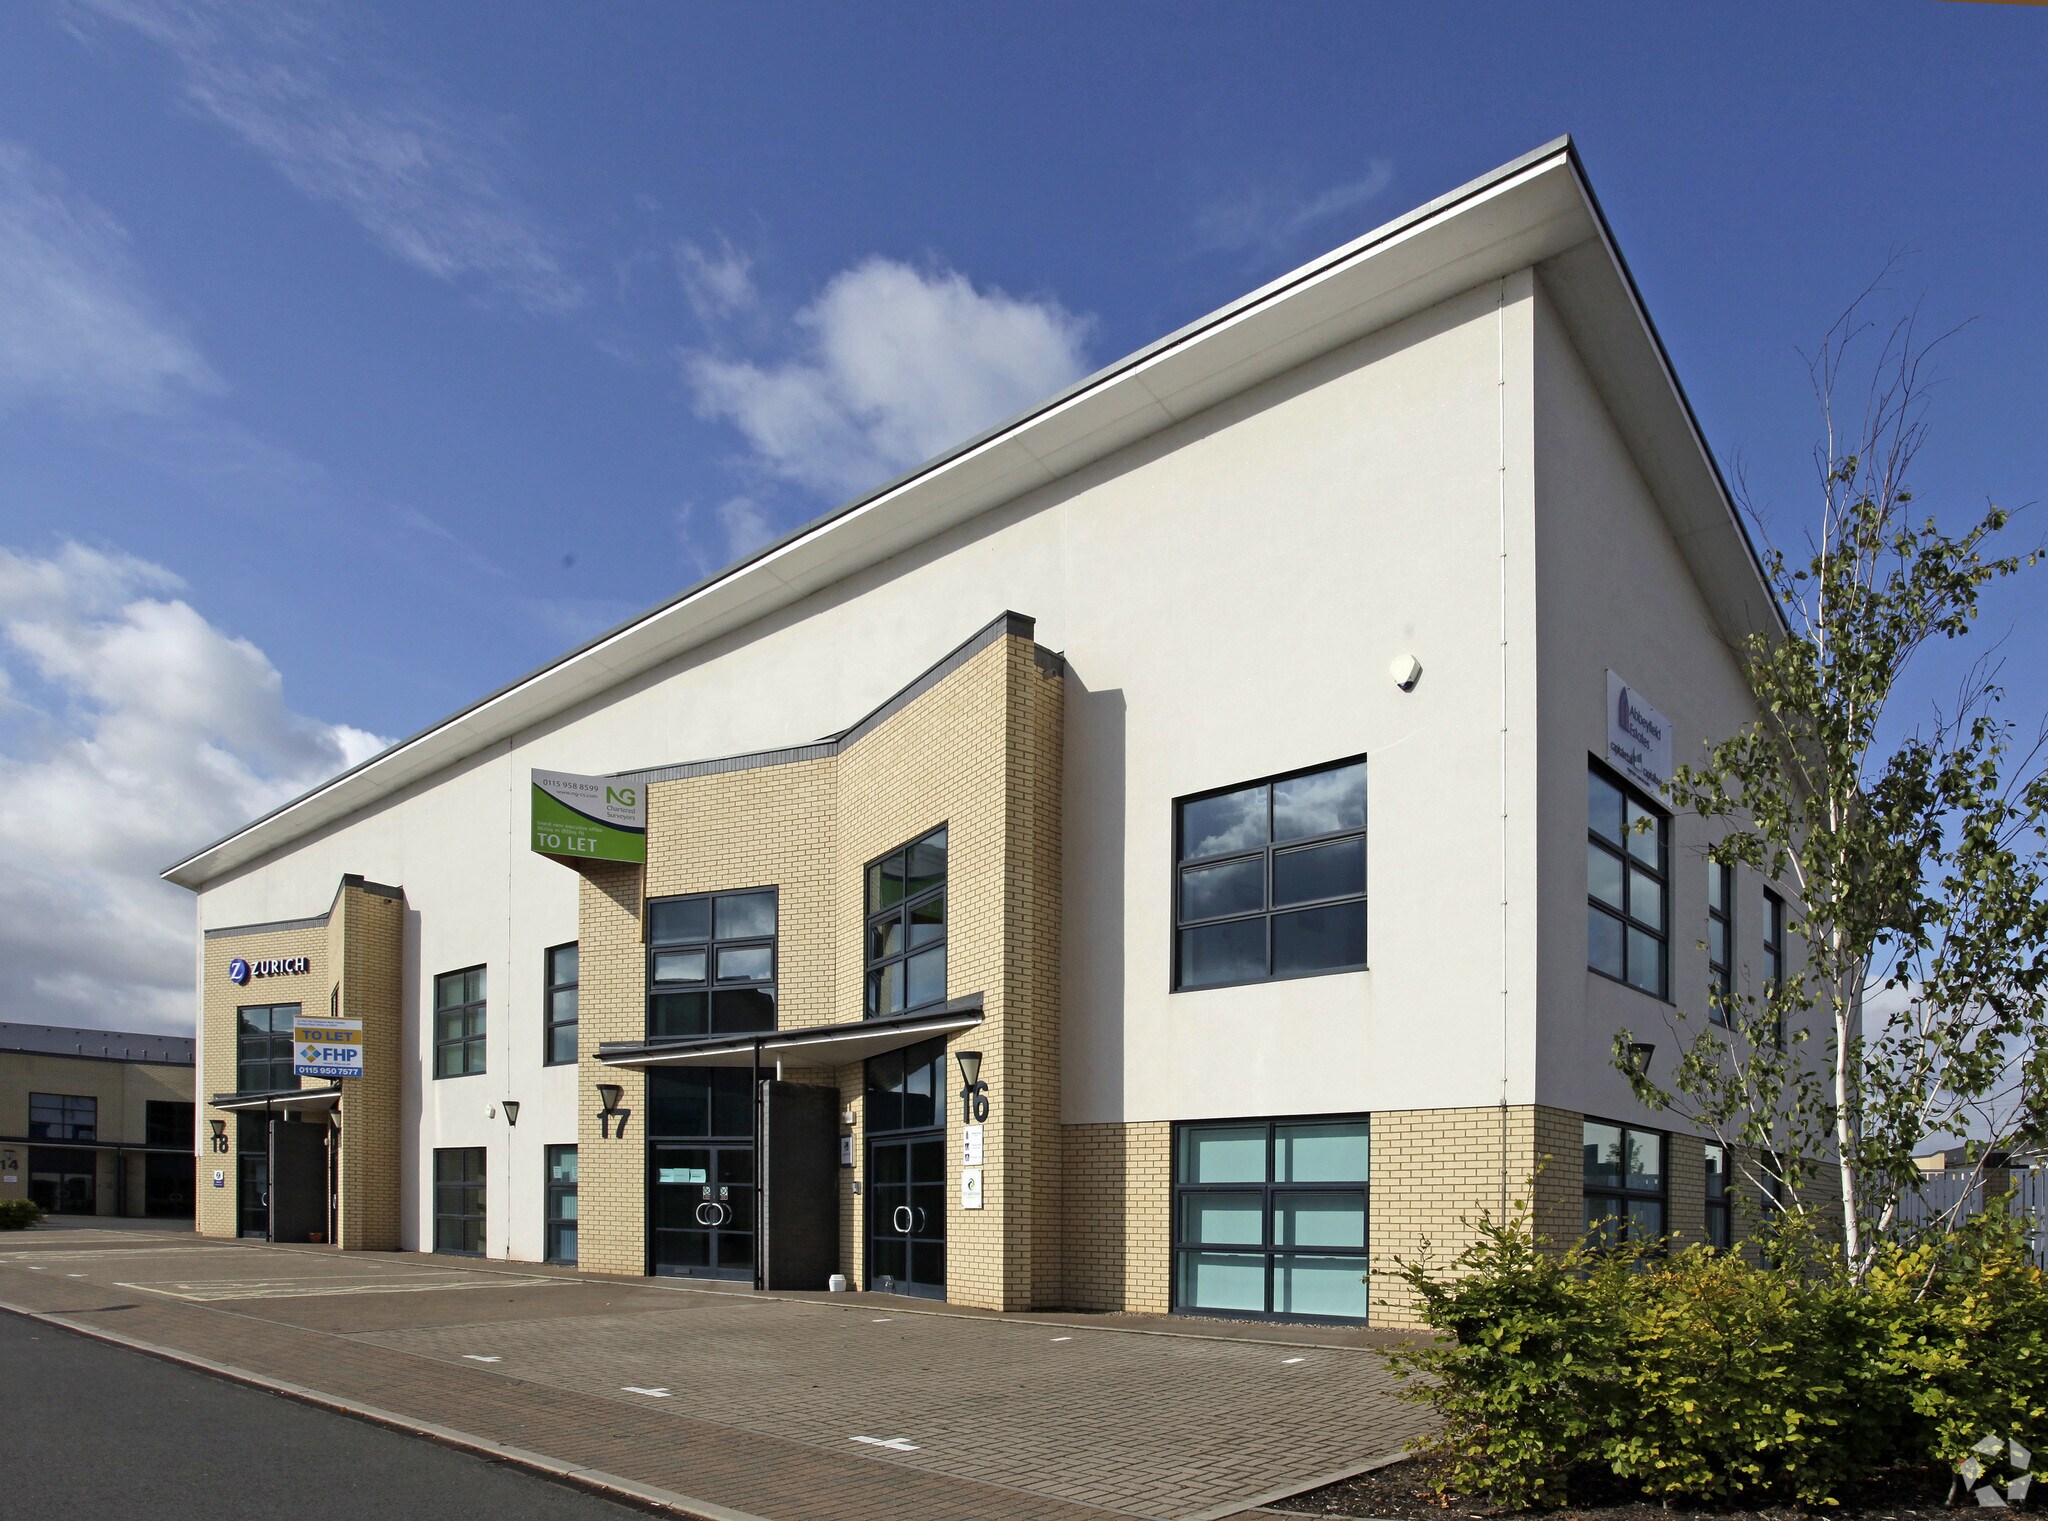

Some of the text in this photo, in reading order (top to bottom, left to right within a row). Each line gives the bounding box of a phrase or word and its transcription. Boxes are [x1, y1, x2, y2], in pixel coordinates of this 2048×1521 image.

[1630, 705, 1661, 740] Abbeyfield
[1630, 723, 1649, 749] Estates
[543, 779, 560, 787] 0115
[580, 784, 598, 792] 8599
[606, 786, 636, 807] NG
[606, 805, 636, 814] Chartered
[606, 811, 636, 820] Surveyors
[537, 832, 597, 852] TO LET
[250, 957, 306, 976] ZURICH
[302, 1030, 353, 1041] TO LET
[323, 1048, 358, 1062] FHP
[960, 1080, 989, 1124] 16
[597, 1108, 631, 1139] 17
[211, 1133, 229, 1153] 18
